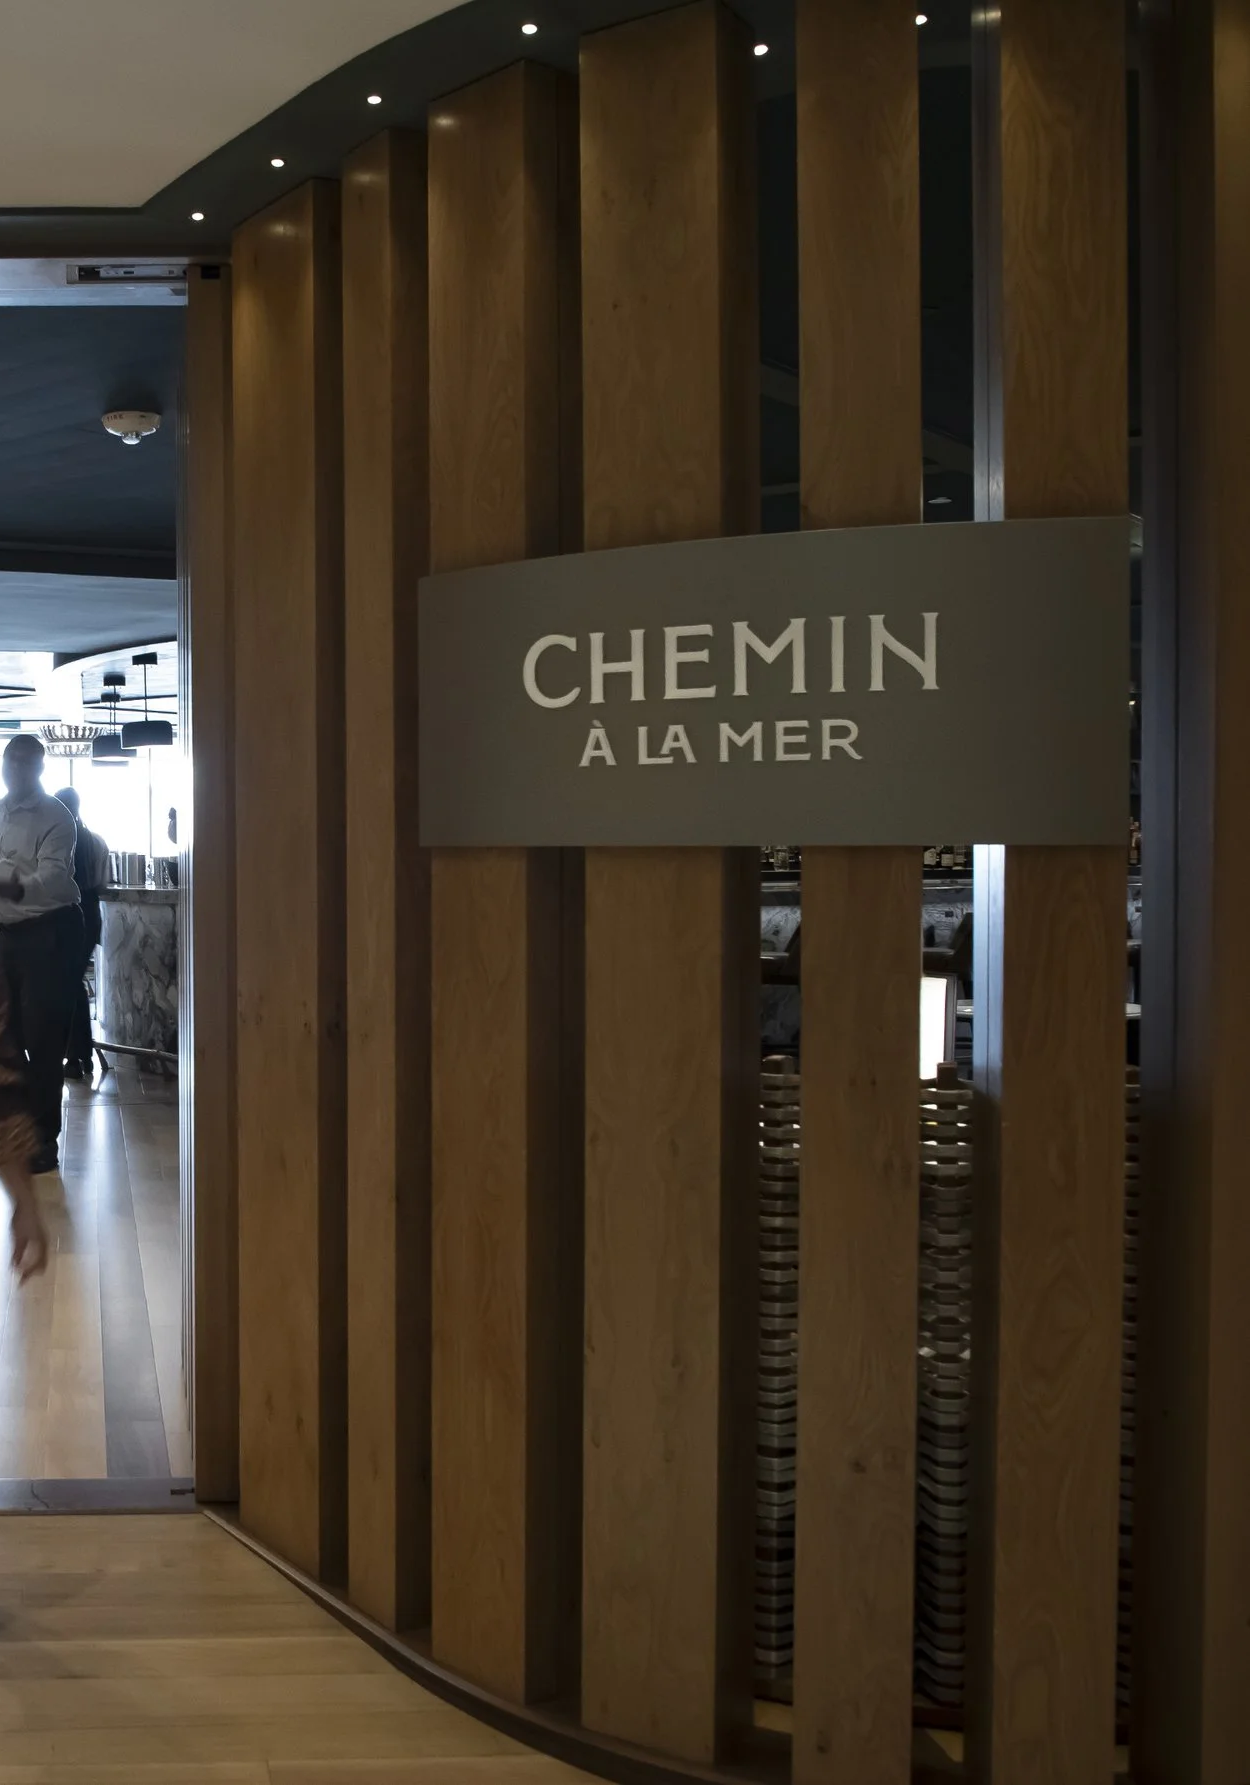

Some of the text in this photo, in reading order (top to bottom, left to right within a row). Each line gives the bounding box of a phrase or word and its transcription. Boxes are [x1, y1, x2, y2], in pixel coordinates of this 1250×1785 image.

[522, 612, 939, 709] CHEMIN
[578, 718, 863, 767] À LA MER
